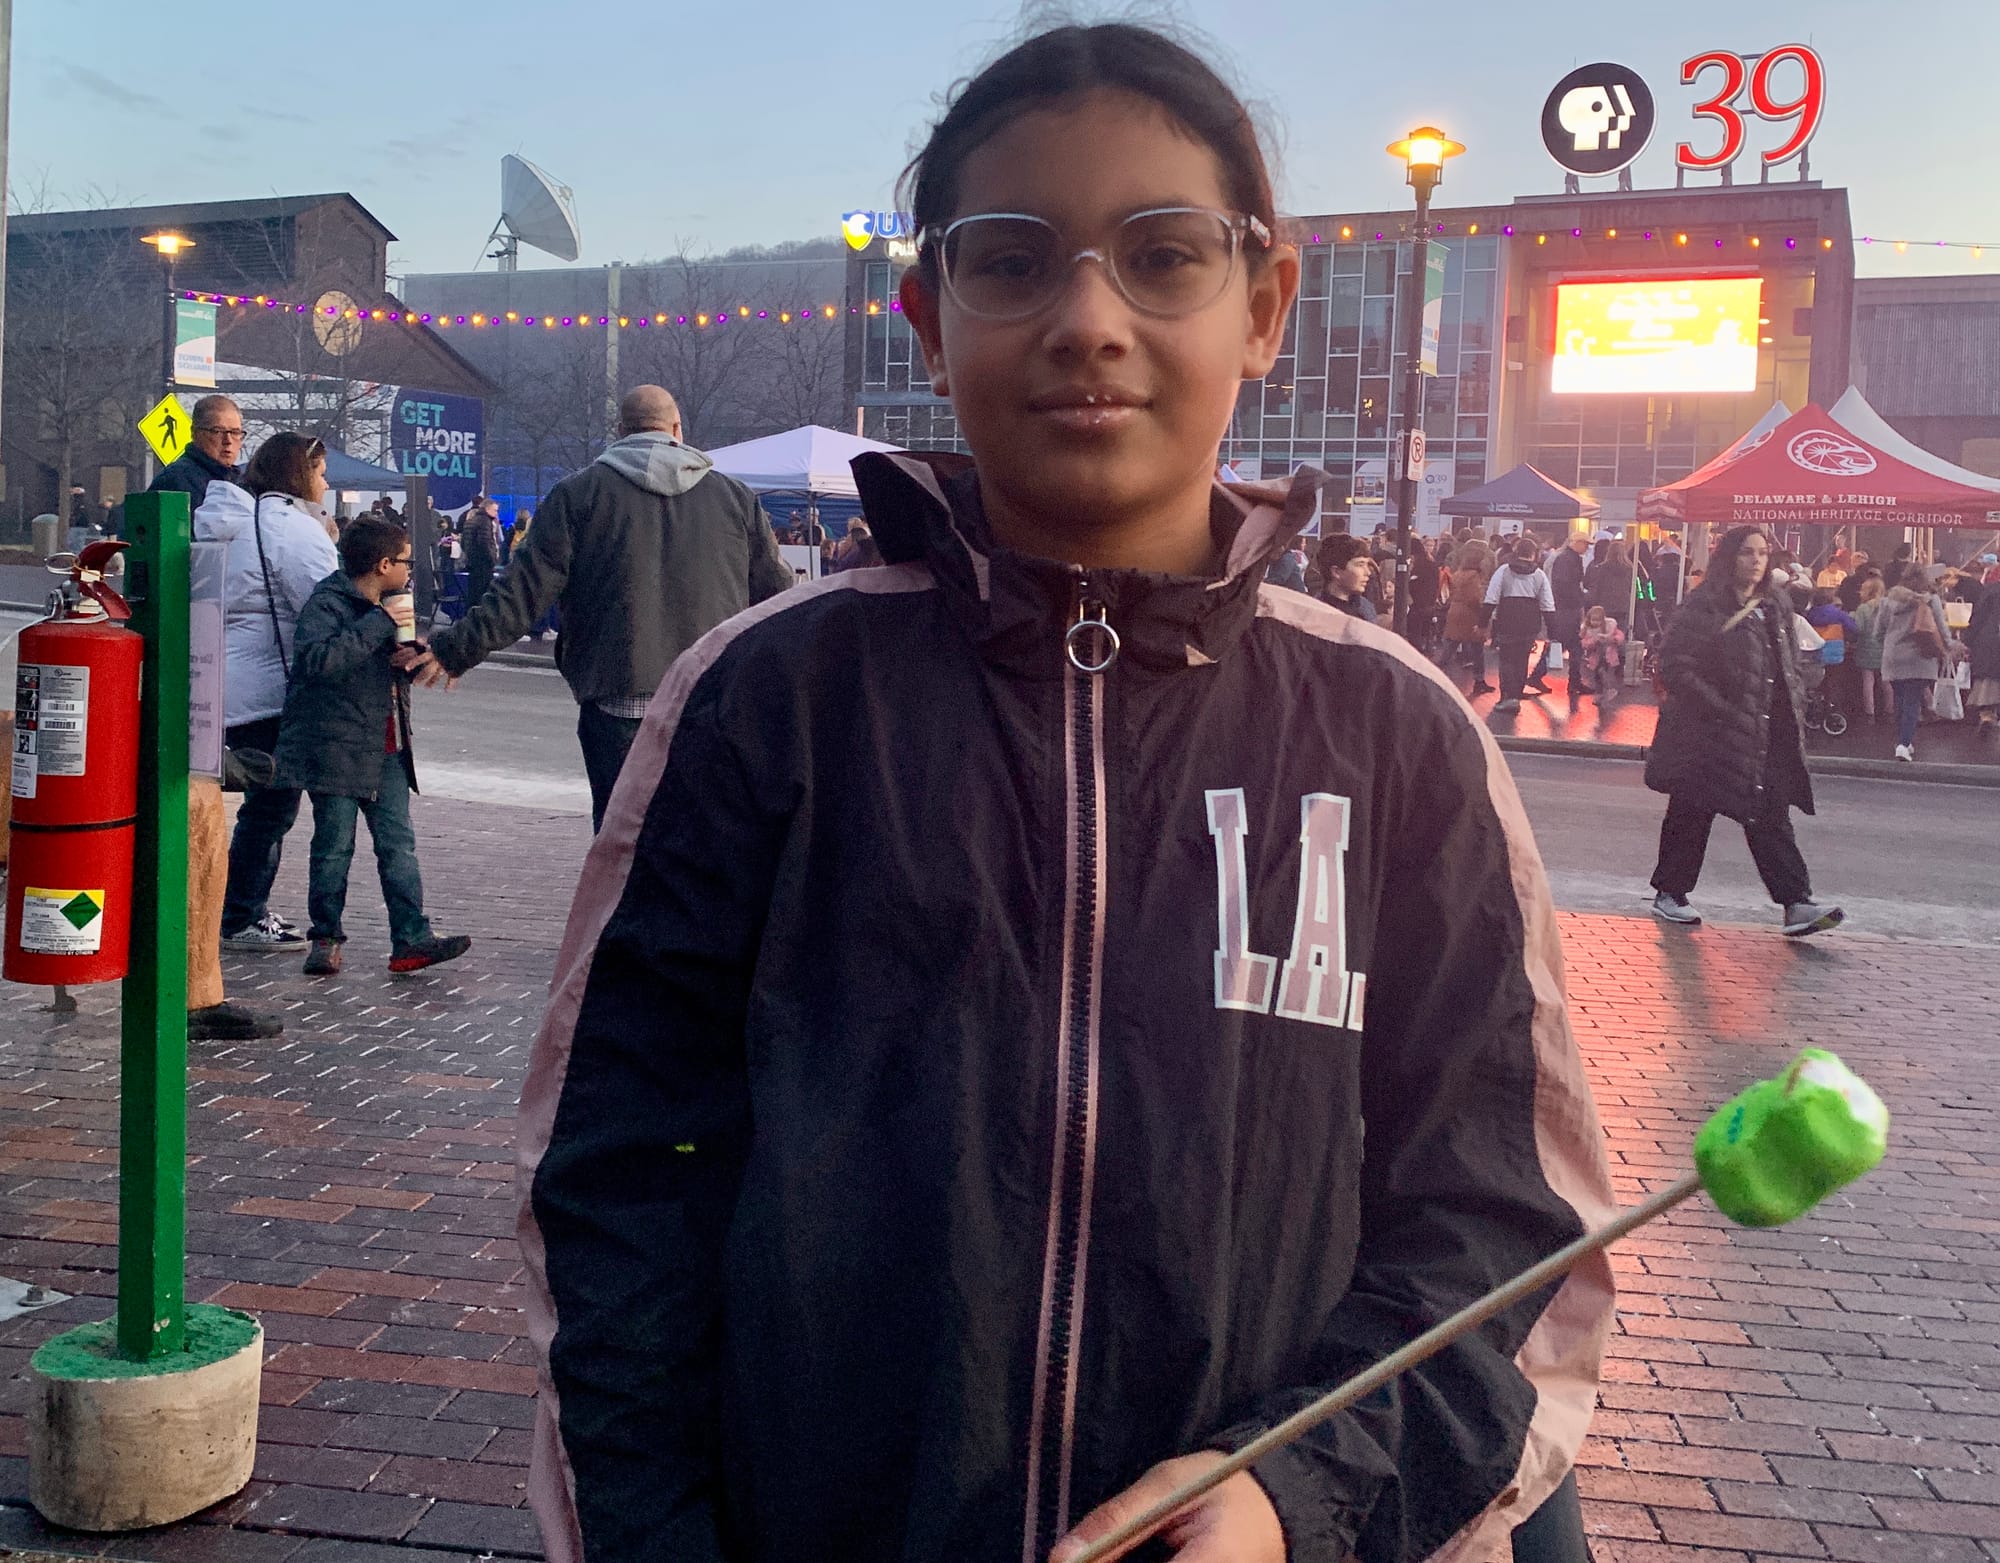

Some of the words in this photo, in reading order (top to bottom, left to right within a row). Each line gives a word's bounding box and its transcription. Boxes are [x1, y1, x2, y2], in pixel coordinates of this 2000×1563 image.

[1674, 43, 1826, 171] 39
[400, 400, 445, 427] GET
[416, 426, 476, 454] MORE
[402, 449, 477, 478] LOCAL
[1733, 494, 1816, 504] DELAWARE
[1821, 494, 1832, 504] &
[1838, 494, 1897, 506] LEHIGH
[1733, 509, 1804, 520] NATIONAL
[1810, 509, 1882, 520] HERITAGE
[1886, 511, 1963, 525] CORRIDOR
